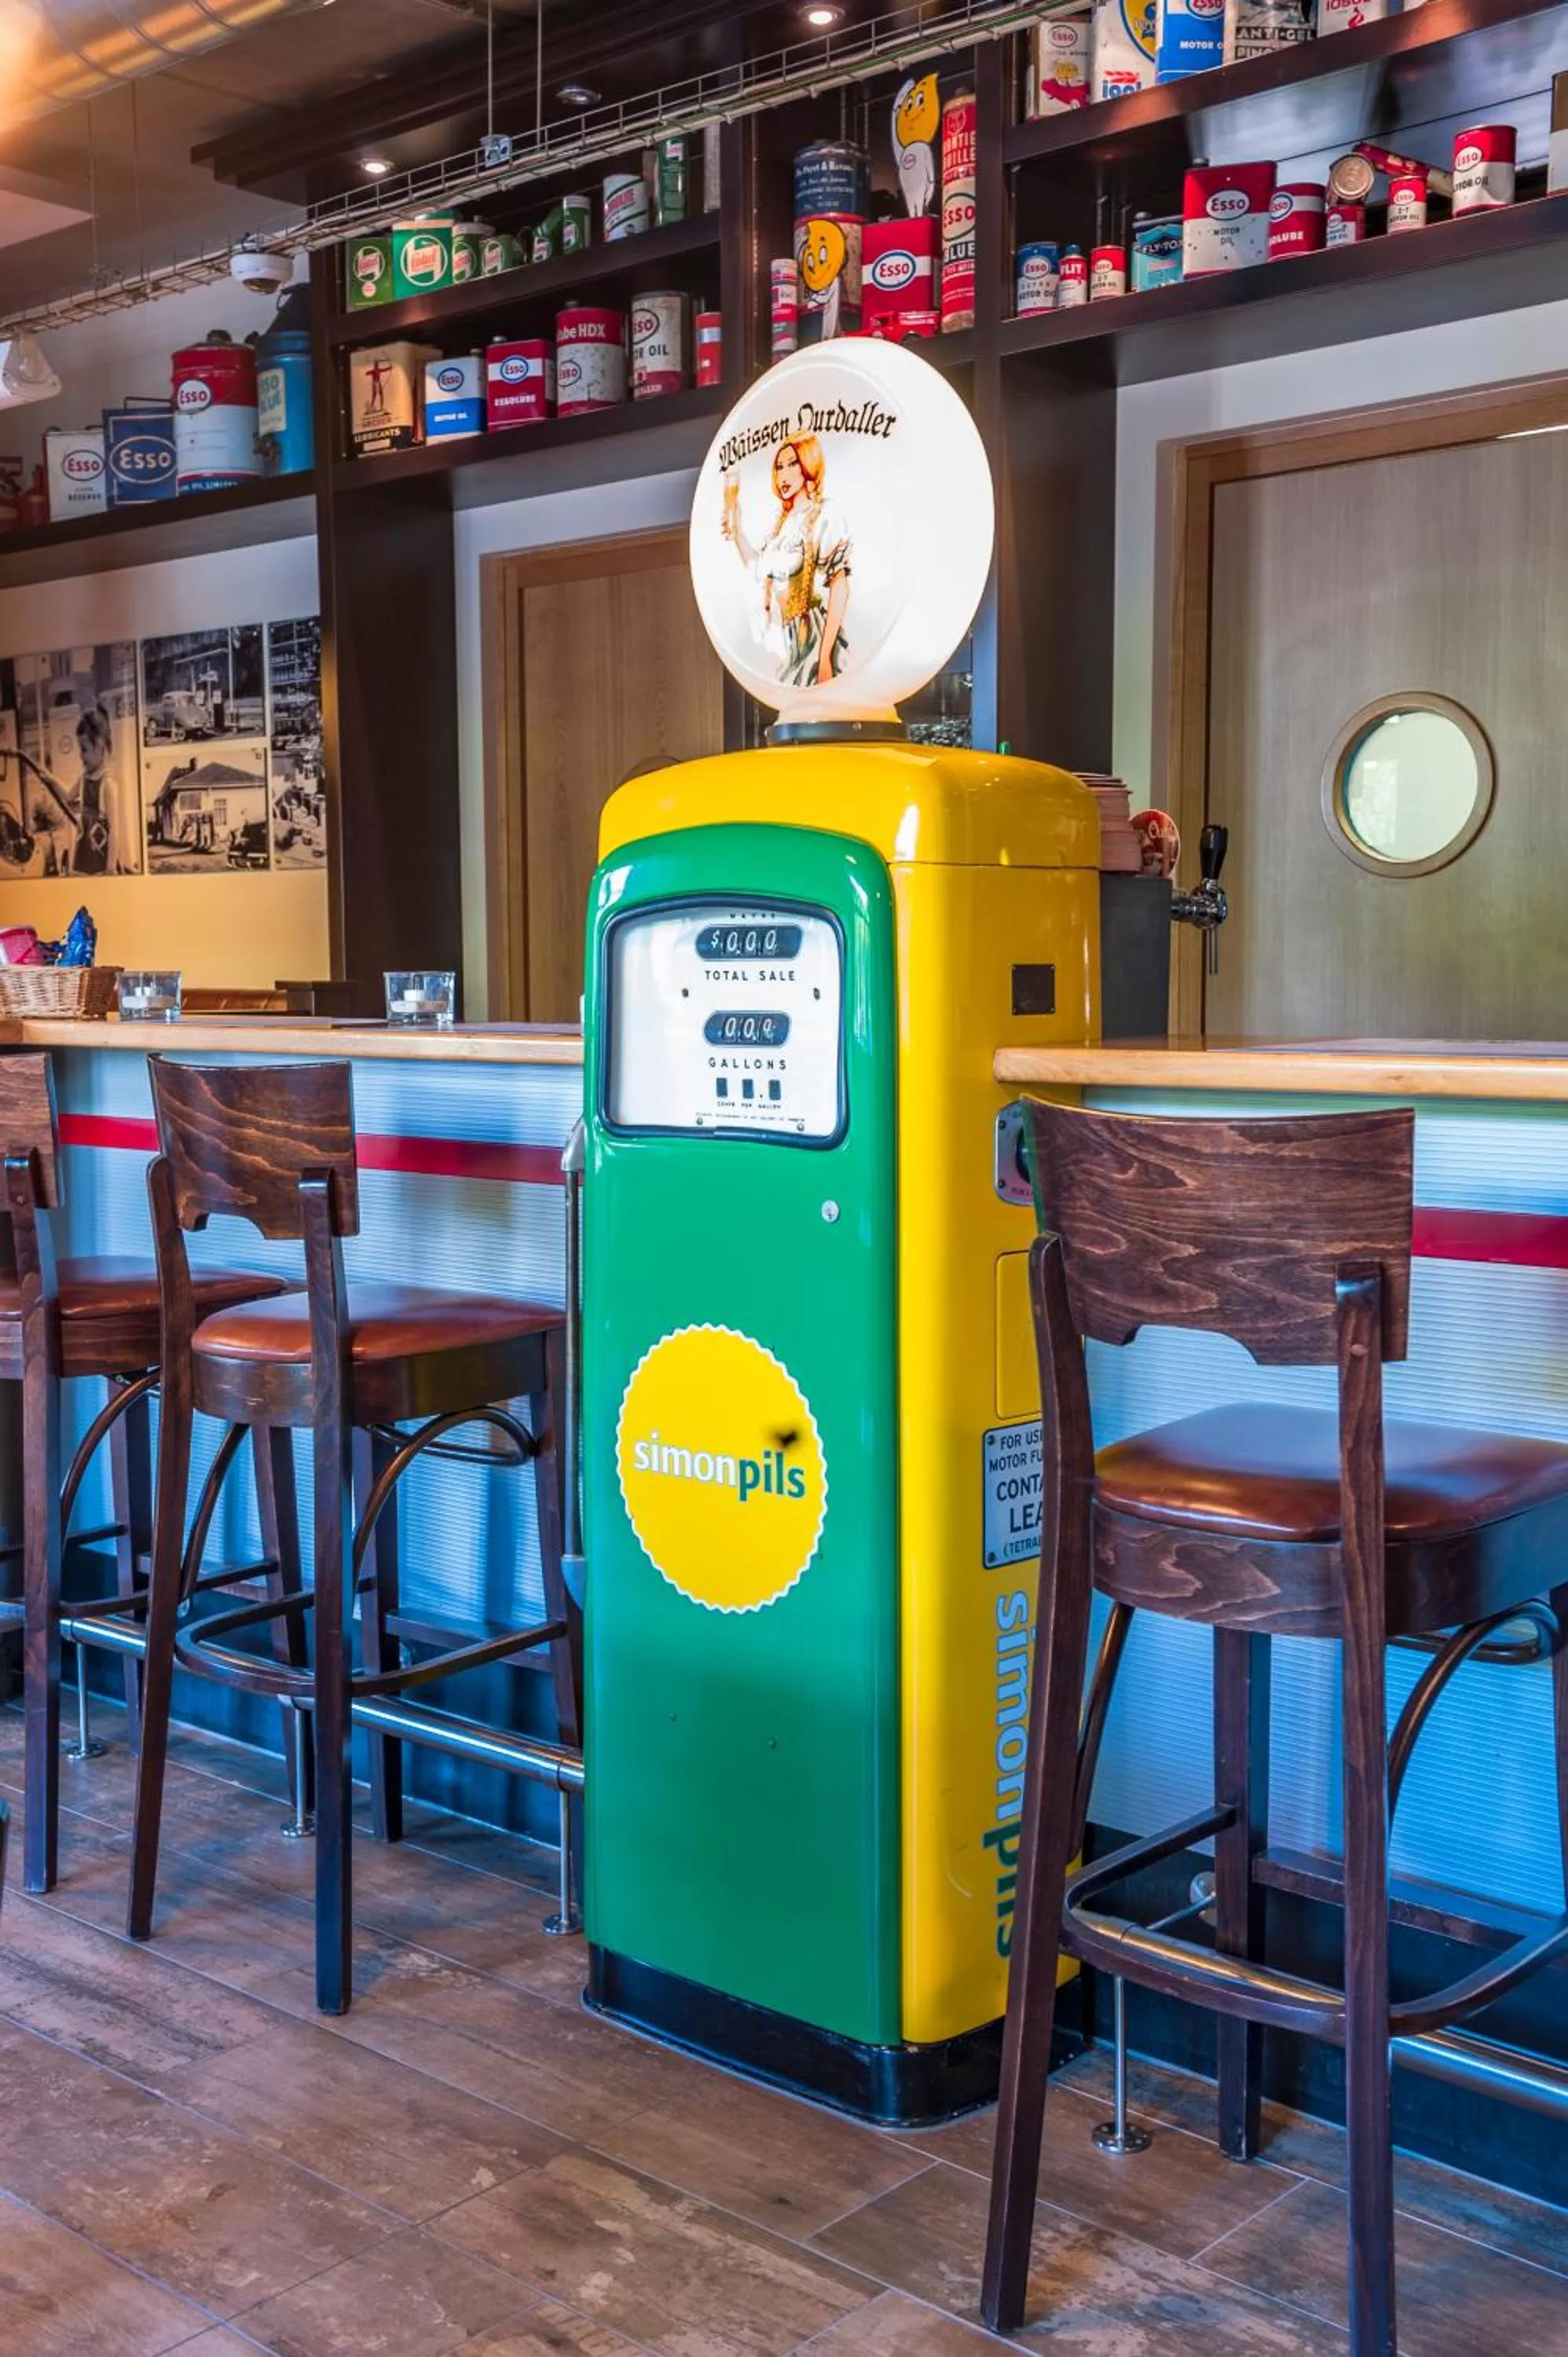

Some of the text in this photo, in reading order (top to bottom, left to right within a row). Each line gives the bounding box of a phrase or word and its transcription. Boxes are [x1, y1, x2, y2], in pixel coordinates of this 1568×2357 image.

[879, 262, 910, 278] Esso
[578, 323, 606, 339] HDX
[68, 457, 101, 472] Esso
[119, 448, 171, 470] Esso
[705, 970, 797, 981] TOTAL SALE
[708, 1057, 787, 1070] GALLONS
[1000, 1433, 1022, 1451] FOR
[633, 1430, 805, 1502] simonpils
[989, 1451, 1028, 1474] MOTOR
